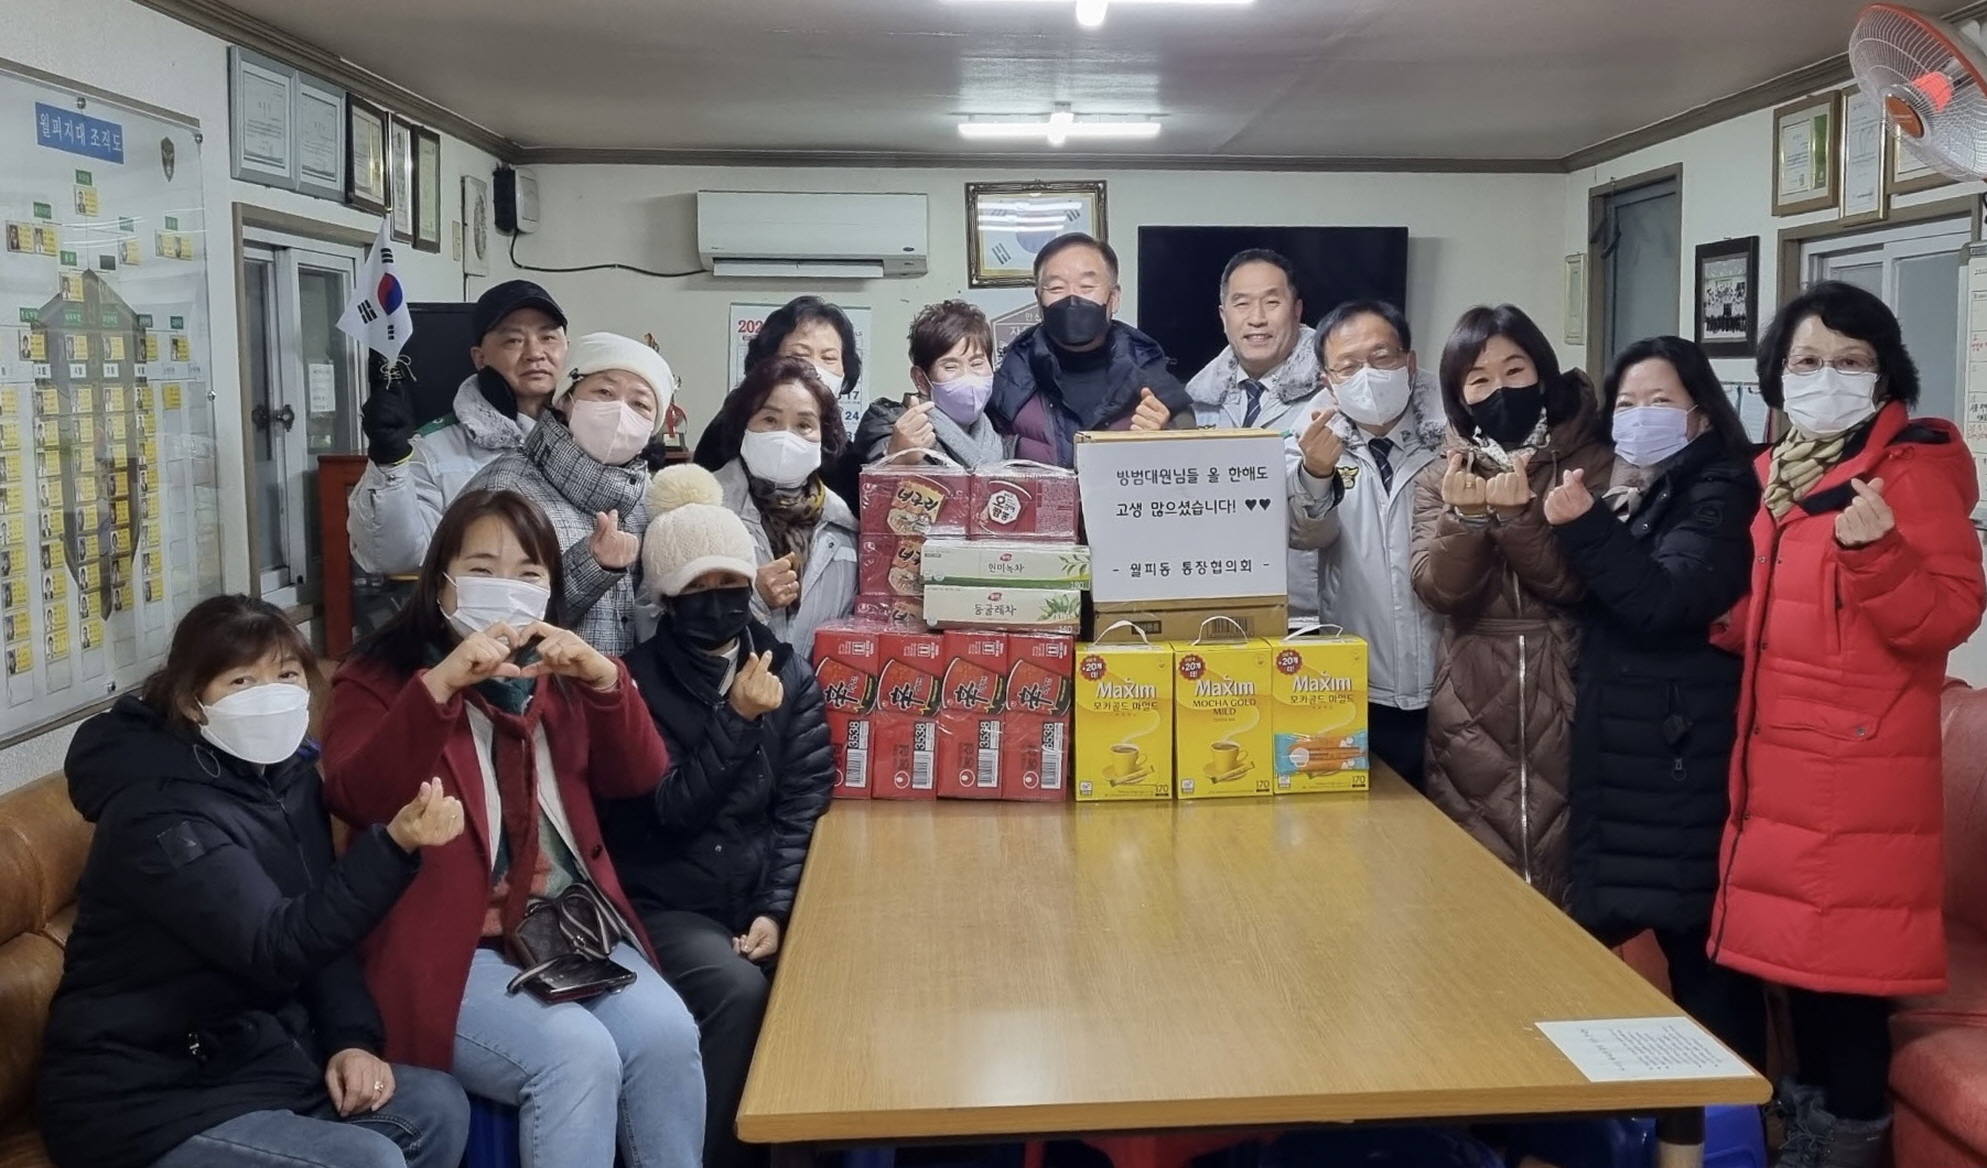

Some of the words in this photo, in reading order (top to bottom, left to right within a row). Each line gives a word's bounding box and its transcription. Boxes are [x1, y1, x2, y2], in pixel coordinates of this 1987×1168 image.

[38, 110, 87, 148] 월피지대
[90, 127, 123, 153] 조직도
[737, 319, 763, 334] 202
[844, 411, 860, 421] 24
[1116, 468, 1200, 487] 방범대원님들
[1206, 467, 1221, 484] 올
[1228, 466, 1269, 483] 한해도
[897, 486, 940, 512] 너구리
[1115, 502, 1143, 518] 고생
[1150, 499, 1237, 518] 많으셨습니다!
[1129, 562, 1171, 579] 월피동
[1181, 559, 1253, 577] 통장협의회
[1096, 679, 1157, 699] Maxim
[1194, 676, 1255, 697] Maxim
[1293, 672, 1353, 692] Maxim
[1093, 701, 1130, 712] 모카골드
[1132, 701, 1159, 712] 마일드
[1193, 699, 1229, 708] MOCHA
[1230, 698, 1257, 707] GOLD
[1213, 707, 1237, 716] MILD
[848, 721, 860, 750] 3538
[915, 723, 927, 751] 3538
[979, 721, 991, 749] 3538
[1155, 783, 1170, 793] 170
[1255, 780, 1269, 789] 170
[1351, 775, 1366, 785] 170
